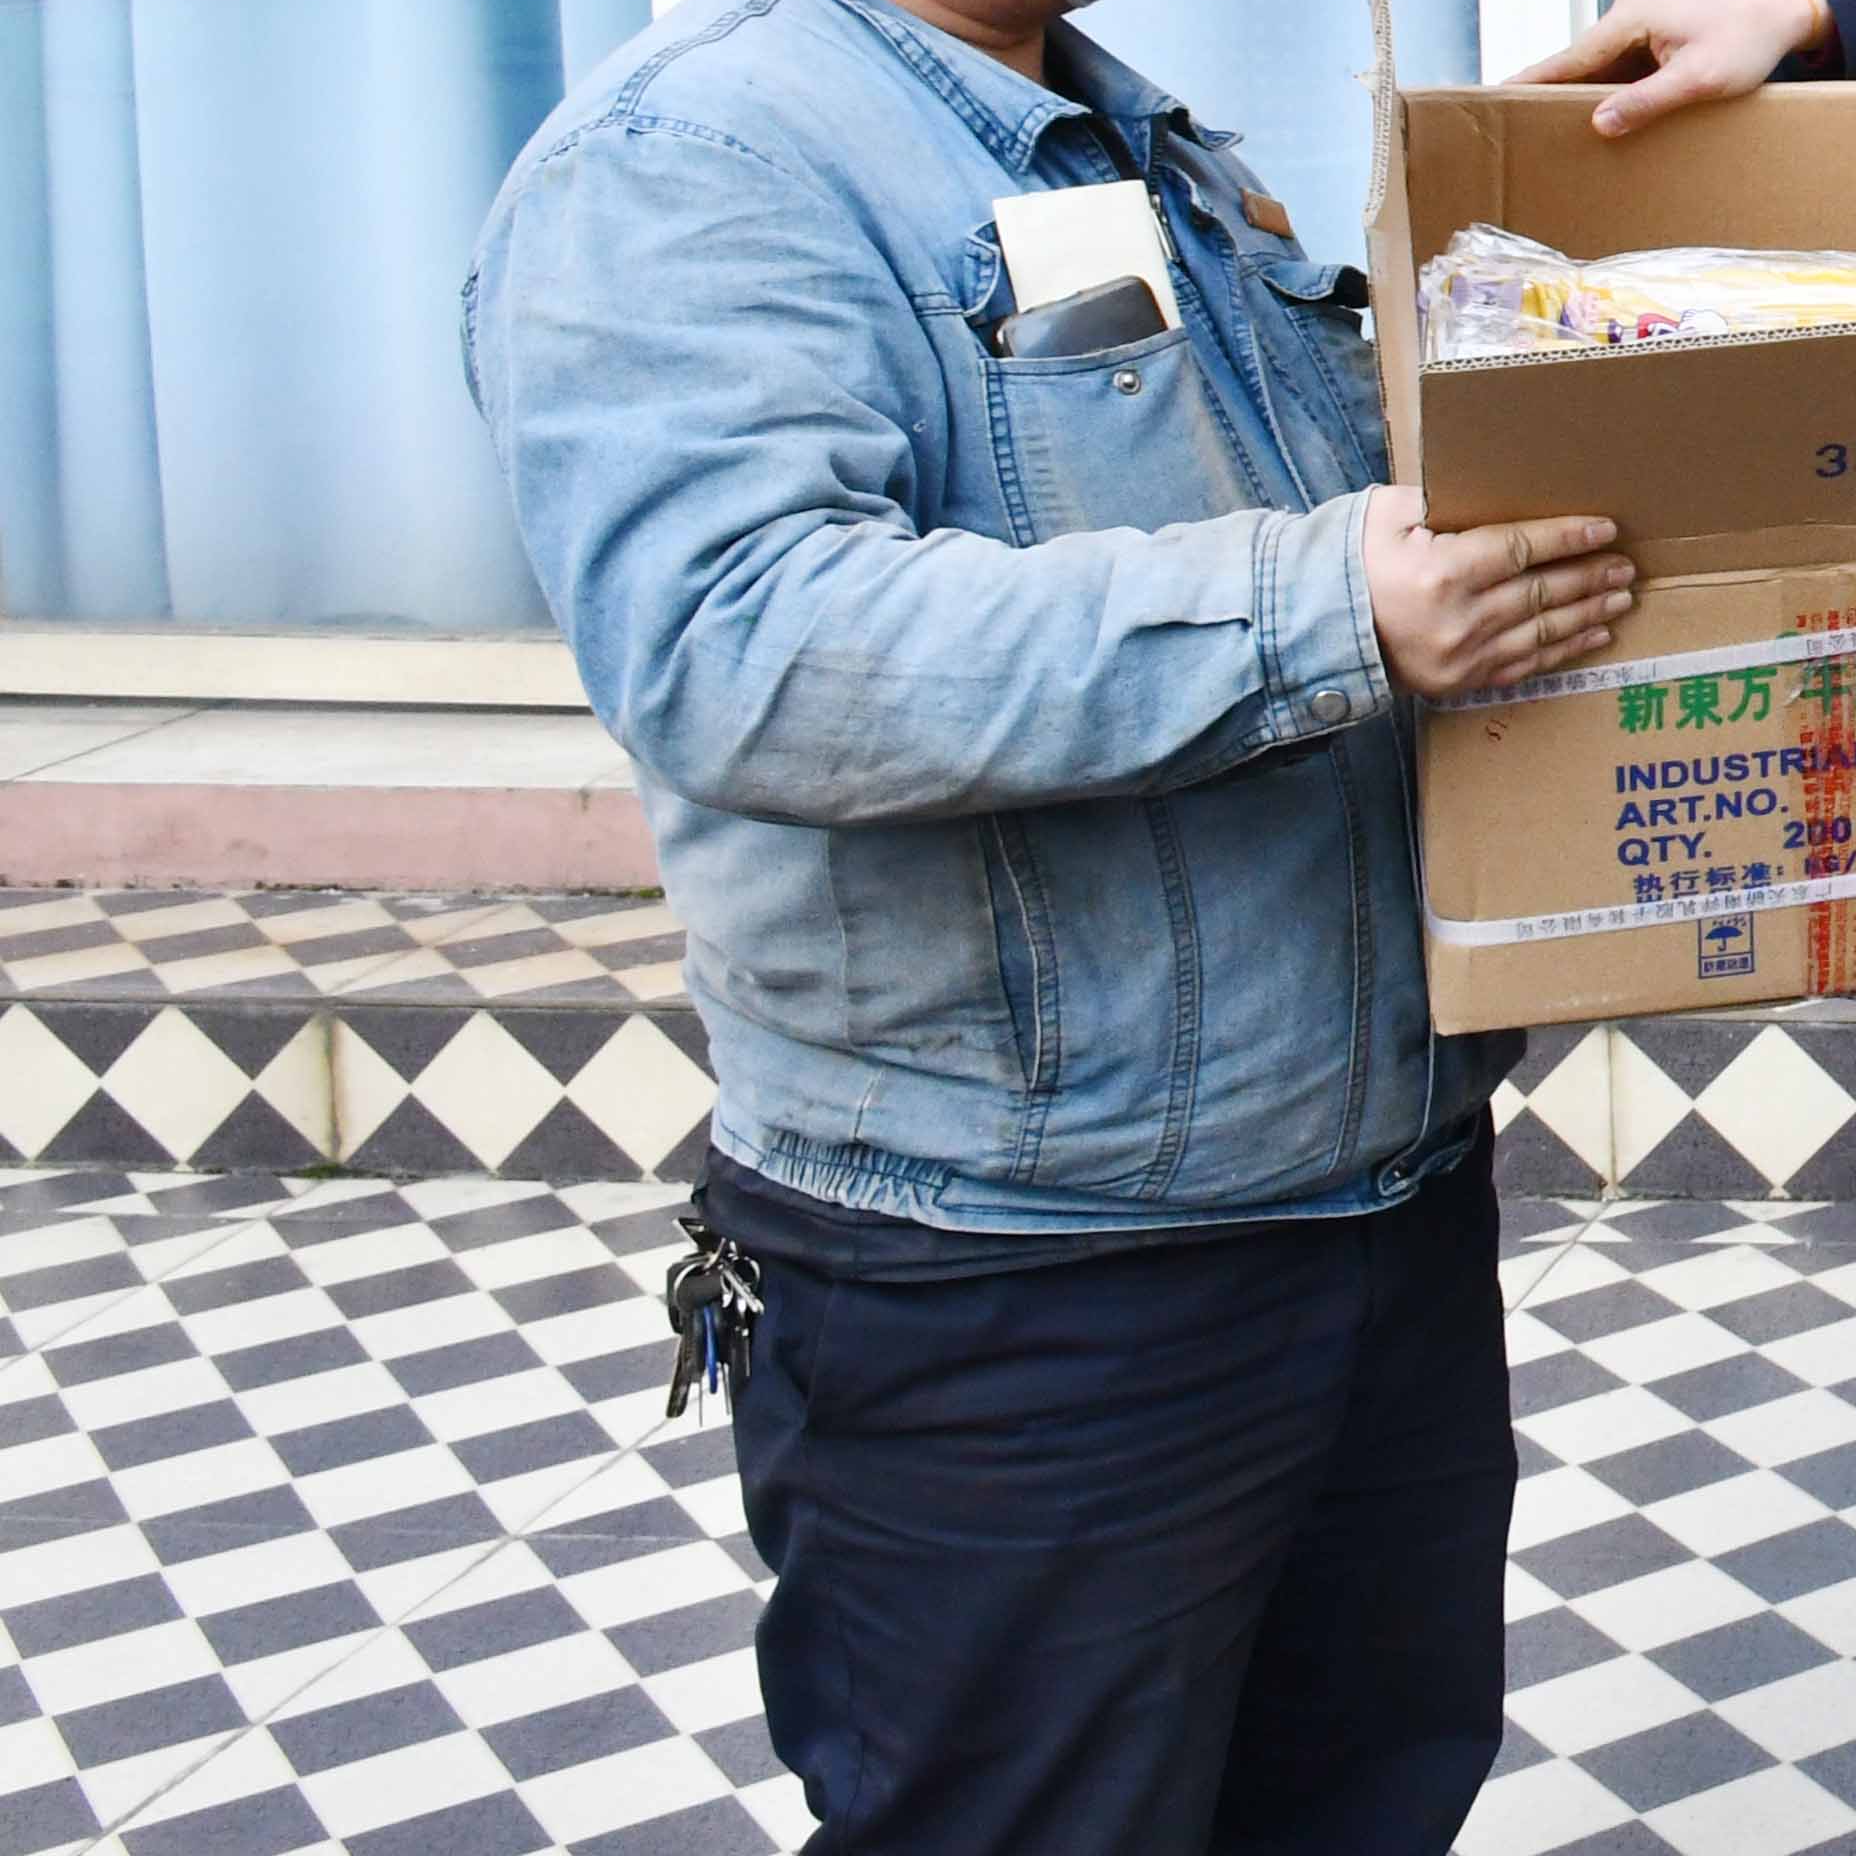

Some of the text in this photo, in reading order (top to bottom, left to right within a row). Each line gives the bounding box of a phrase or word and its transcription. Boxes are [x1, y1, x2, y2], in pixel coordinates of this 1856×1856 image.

[1618, 666, 1777, 733] 新東方
[1616, 788, 1788, 830] ART.NO.
[1618, 832, 1712, 866] QTY.
[1783, 817, 1851, 849] 200
